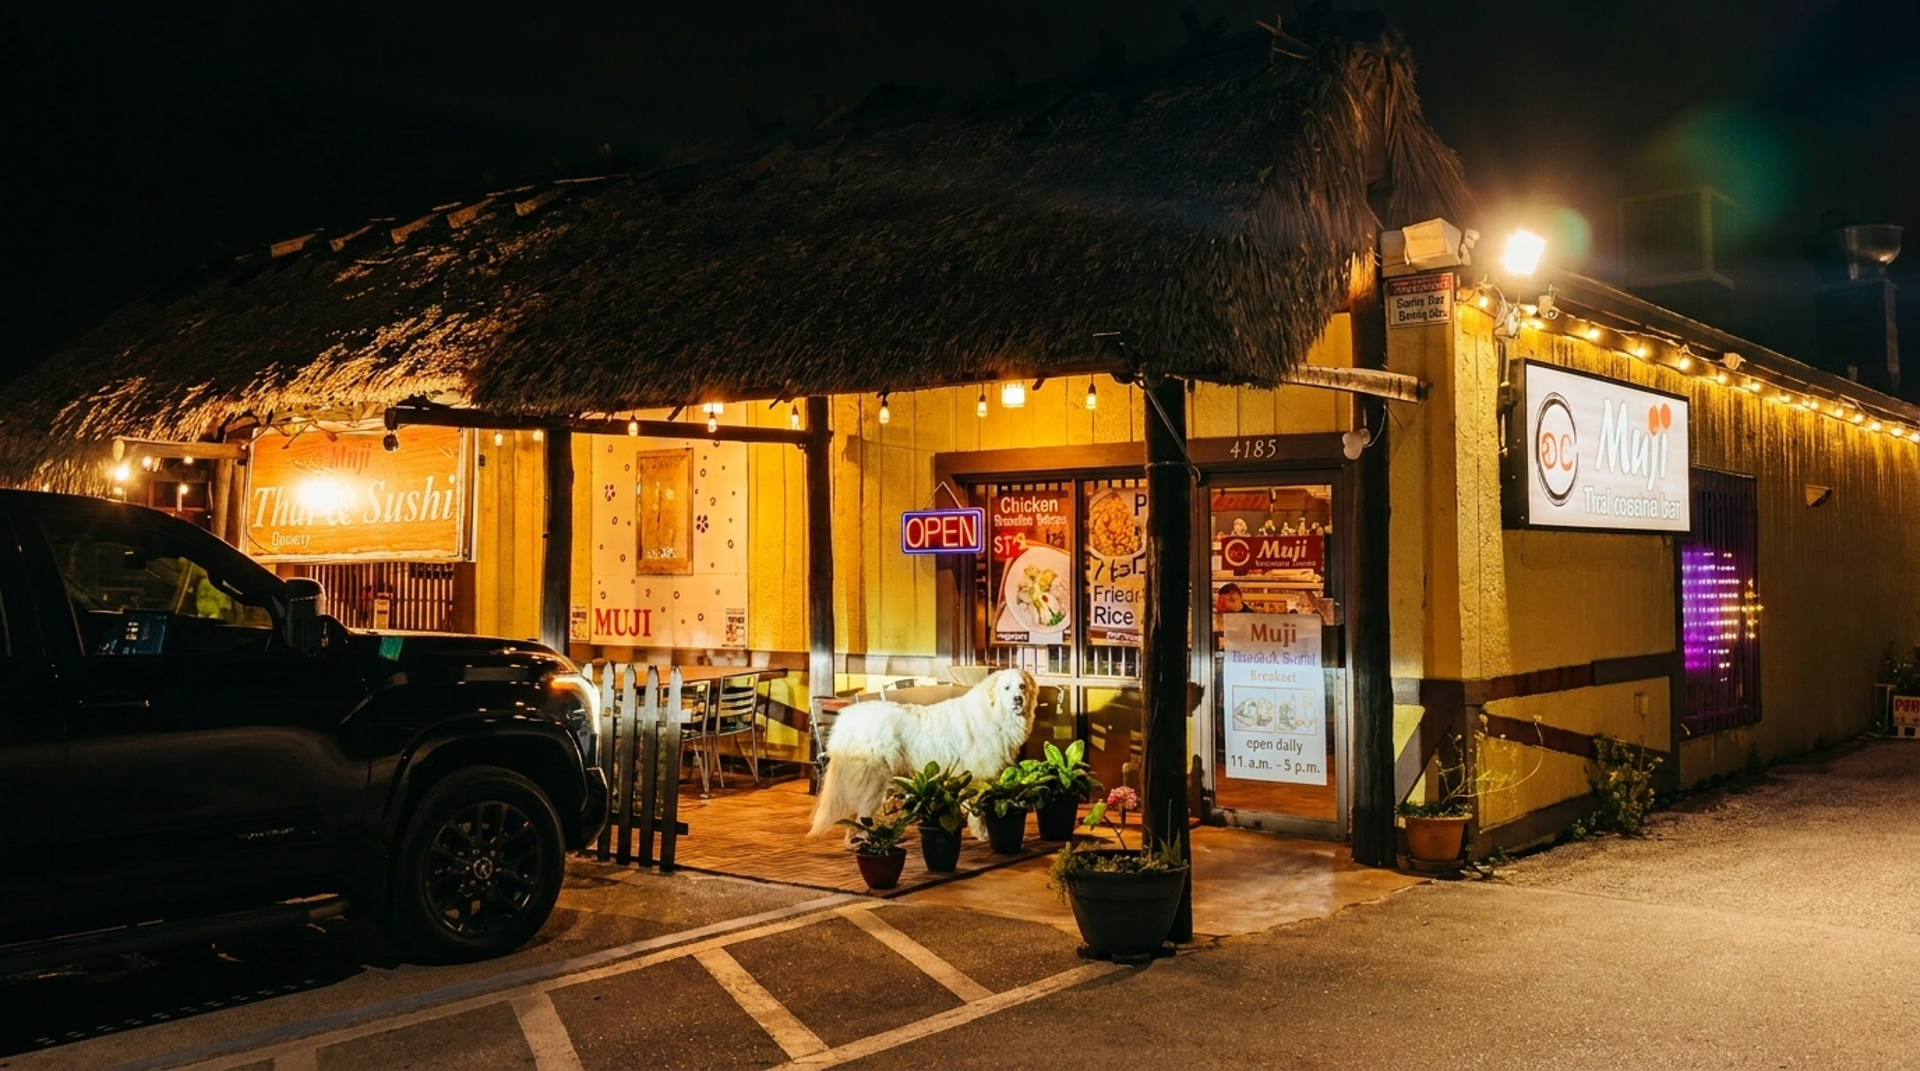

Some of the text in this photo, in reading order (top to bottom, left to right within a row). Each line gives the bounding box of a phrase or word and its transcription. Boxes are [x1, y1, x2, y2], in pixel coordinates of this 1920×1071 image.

[1230, 439, 1278, 459] 4185
[1595, 397, 1672, 491] Muji
[362, 474, 457, 525] Sushi
[1000, 495, 1059, 514] Chicken
[905, 515, 977, 549] OPEN
[1256, 539, 1308, 563] Muji
[594, 608, 652, 638] MUJI
[1094, 607, 1134, 625] Rice
[1250, 623, 1297, 647] Muji
[1284, 759, 1291, 772] 5
[1295, 762, 1321, 775] p.m.
